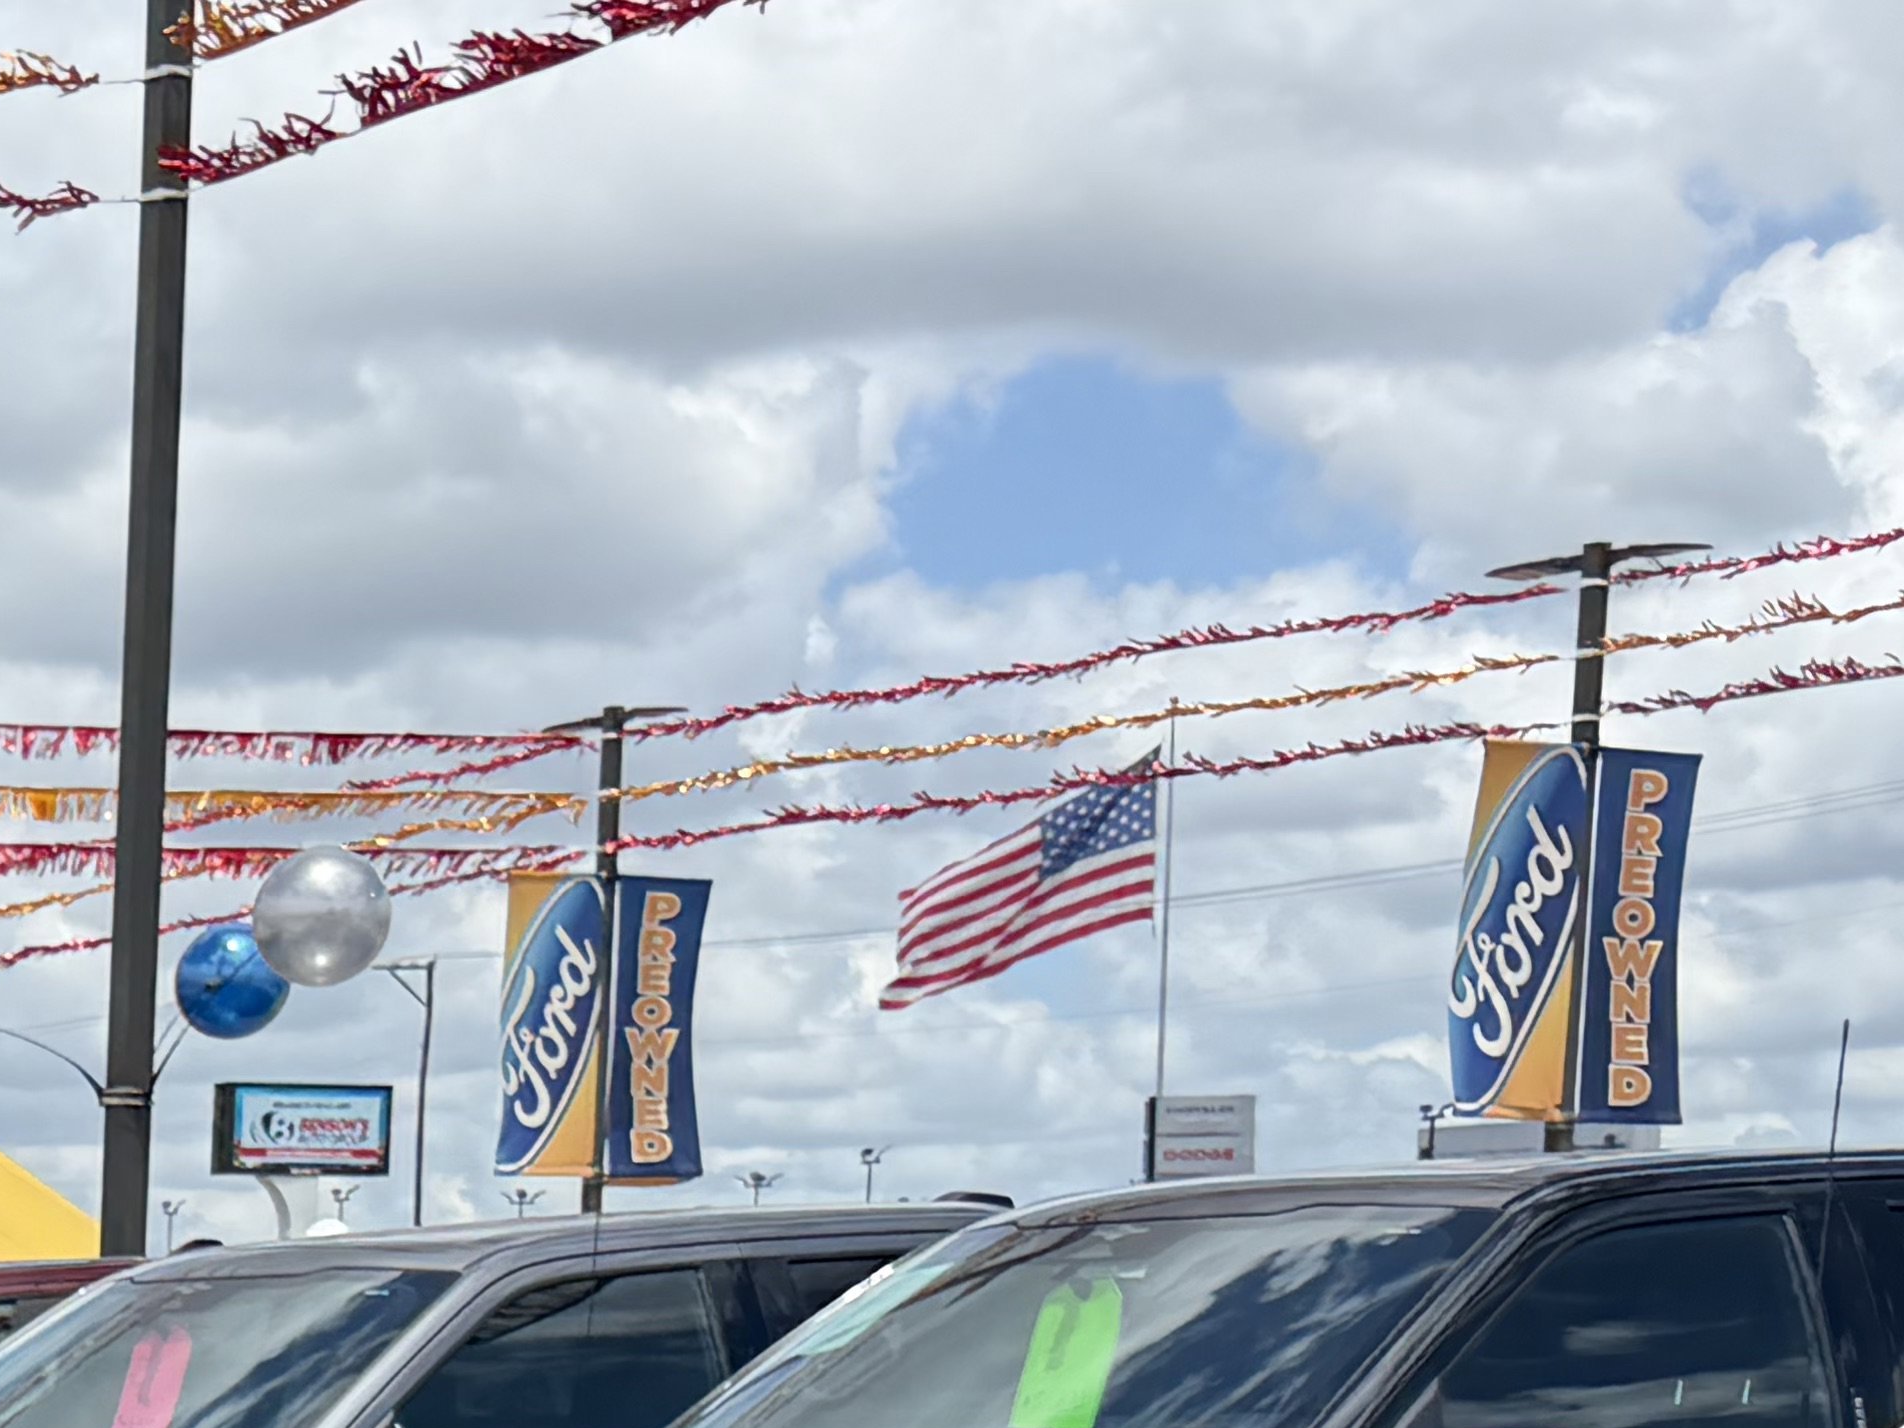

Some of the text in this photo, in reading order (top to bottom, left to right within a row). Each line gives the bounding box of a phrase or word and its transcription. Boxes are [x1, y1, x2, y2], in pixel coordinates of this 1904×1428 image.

[501, 924, 597, 1128] Ford
[624, 891, 682, 1164] PREOWNED
[1448, 804, 1574, 1058] Ford
[1602, 768, 1669, 1107] PREOWNED
